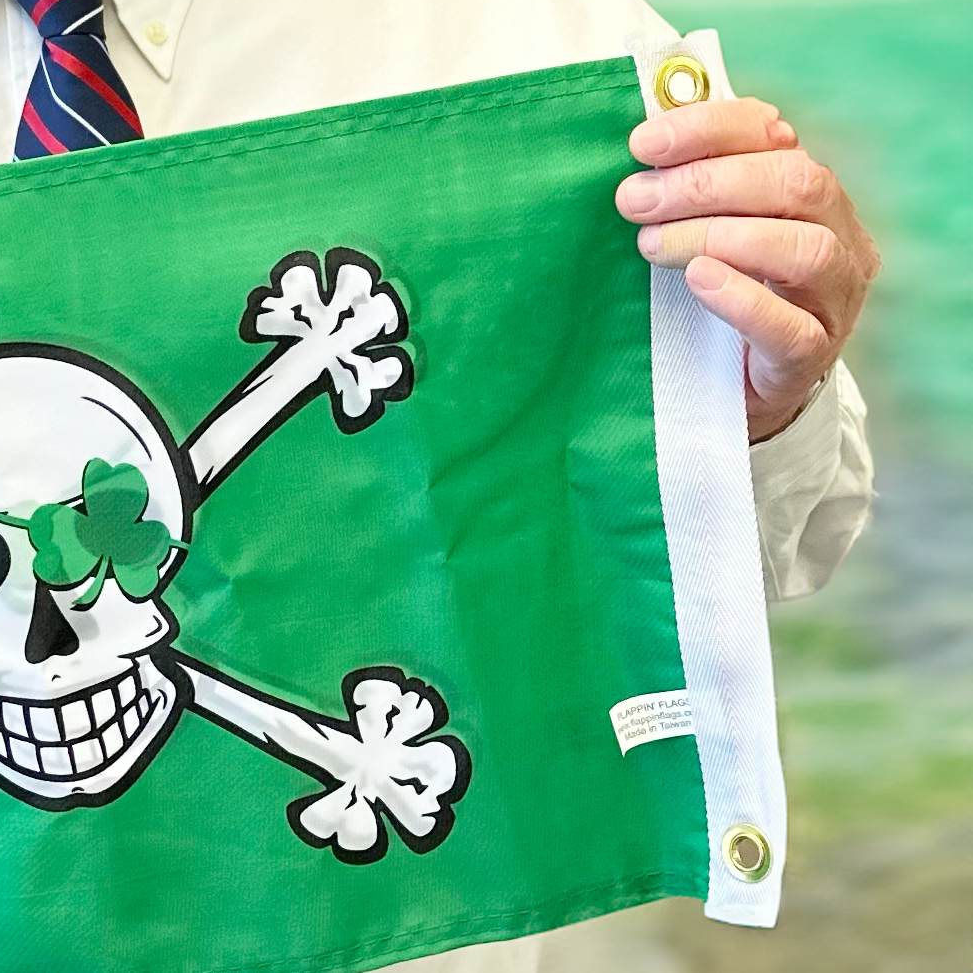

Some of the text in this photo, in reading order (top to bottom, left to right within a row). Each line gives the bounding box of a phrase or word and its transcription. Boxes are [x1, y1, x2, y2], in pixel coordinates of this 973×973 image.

[624, 720, 692, 741] Made in Taiwan
